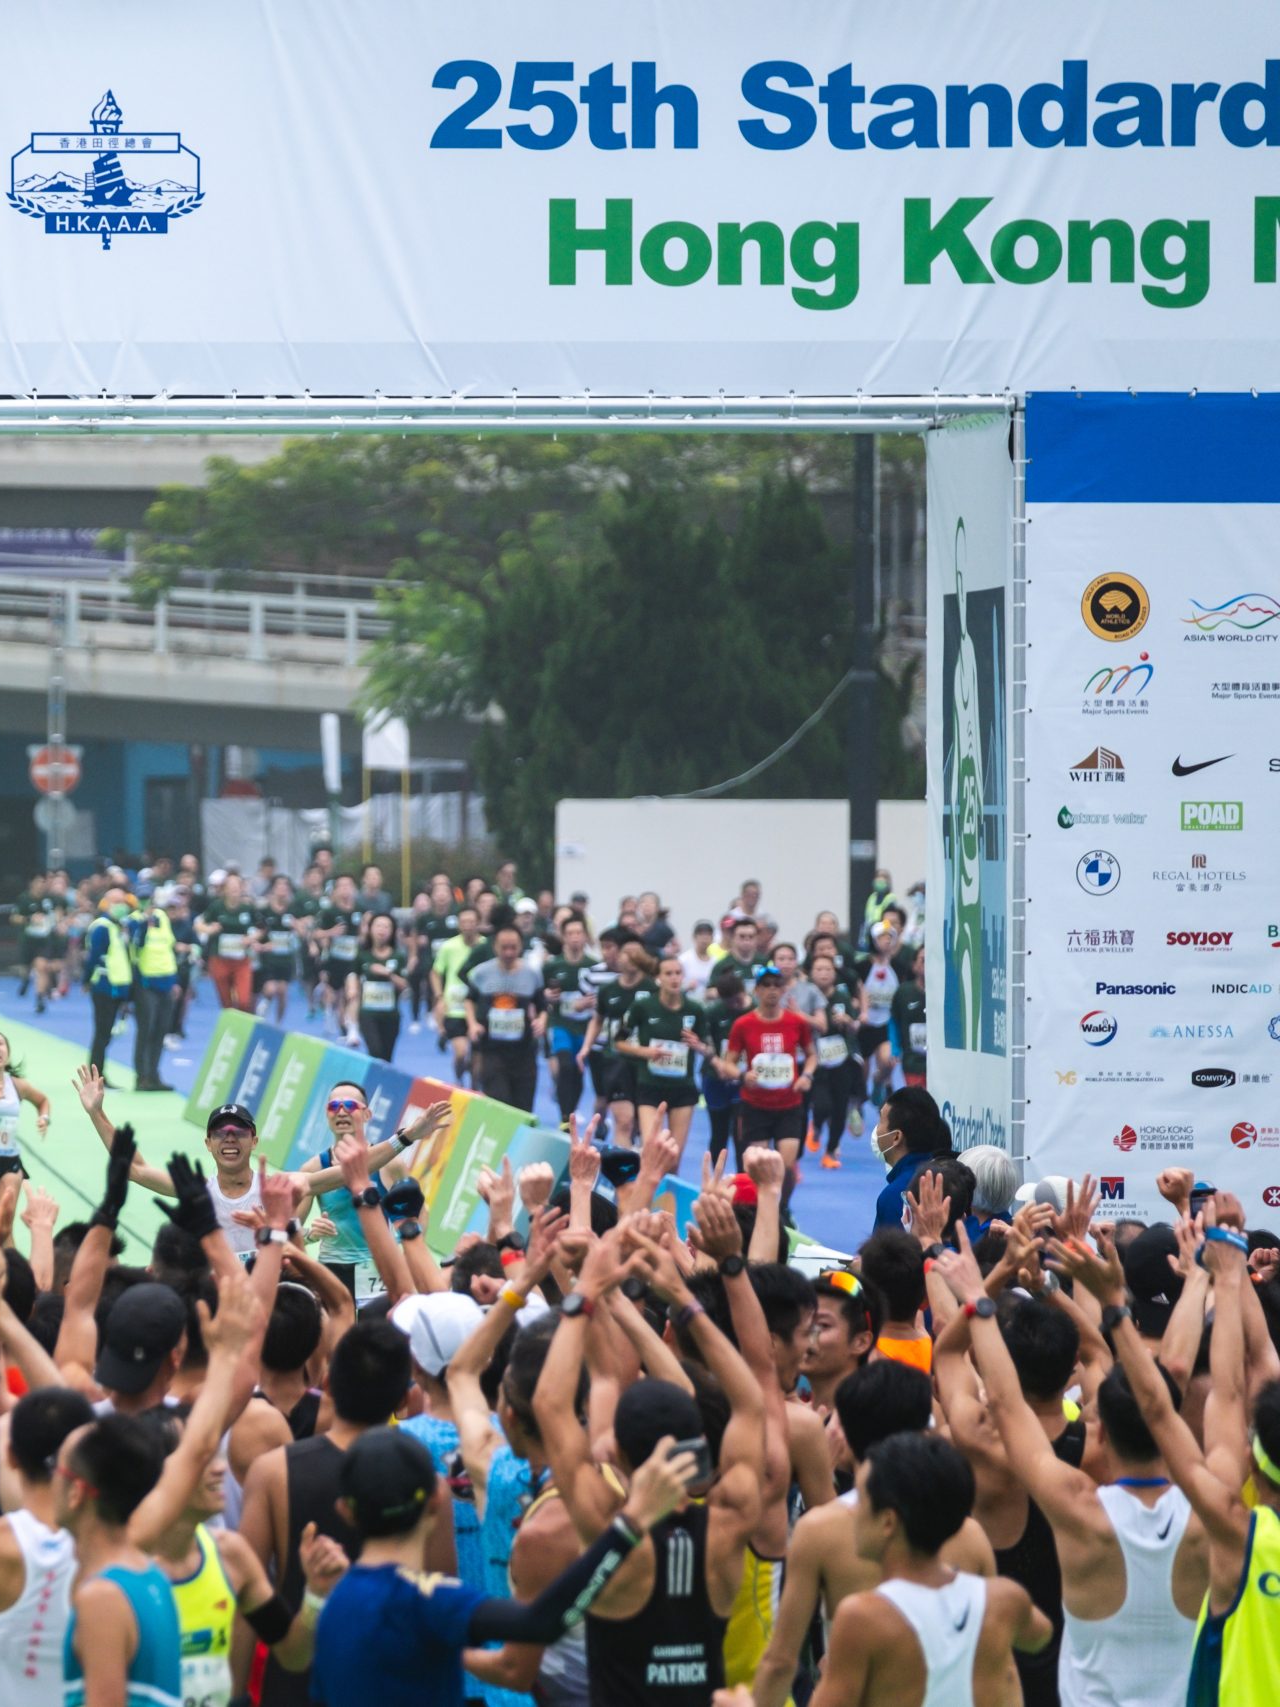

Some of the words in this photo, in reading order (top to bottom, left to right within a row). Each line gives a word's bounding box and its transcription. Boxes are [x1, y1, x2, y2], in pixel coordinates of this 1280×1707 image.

[430, 60, 698, 150] 25th
[738, 59, 1280, 150] Standard
[59, 137, 152, 149] 香港田徑總會
[55, 216, 156, 231] H.K.A.A.A.
[549, 199, 859, 310] Hong
[904, 197, 1210, 308] Kong
[1184, 634, 1215, 642] ASIA'S
[1217, 634, 1253, 642] WORLD
[1255, 634, 1279, 642] CITY
[1211, 692, 1231, 700] Major
[1233, 692, 1256, 700] Sports
[1069, 771, 1102, 782] WHT
[963, 776, 976, 834] 25
[1184, 803, 1240, 825] POAD
[1153, 871, 1192, 880] REGAL
[1197, 871, 1246, 880] HOTELS
[1067, 929, 1135, 946] 六福珠寶
[1166, 931, 1233, 946] SOYJOY
[1096, 982, 1176, 995] Panasonic
[1212, 984, 1271, 994] INDICAID
[1082, 1022, 1115, 1033] Walch
[1174, 1025, 1234, 1038] ANESSA
[1195, 1074, 1228, 1082] COMVITA
[1140, 1126, 1166, 1134] HONG
[1168, 1126, 1194, 1134] KONG
[648, 1662, 707, 1684] PATRICK
